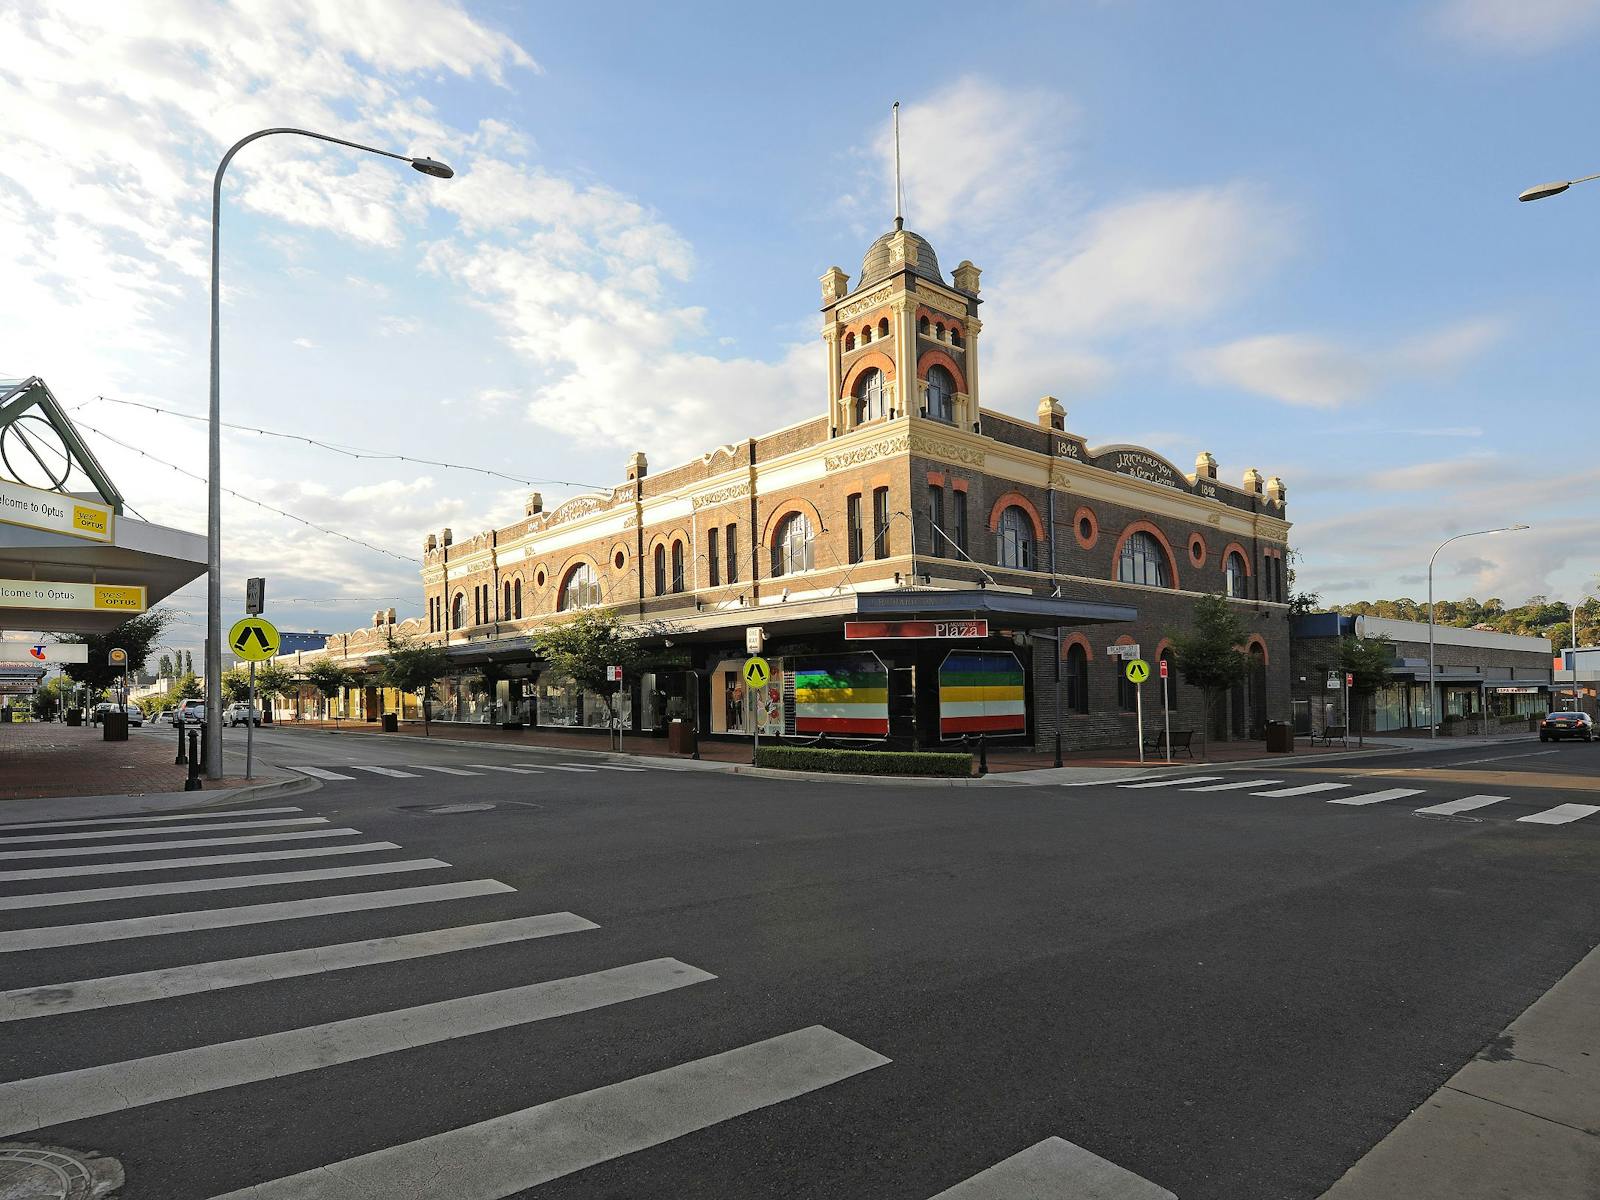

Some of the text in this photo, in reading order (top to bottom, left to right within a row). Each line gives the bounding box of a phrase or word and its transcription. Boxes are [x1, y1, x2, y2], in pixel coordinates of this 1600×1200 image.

[1057, 441, 1078, 457] 1842
[1201, 484, 1216, 497] 1842
[30, 502, 39, 513] to
[41, 503, 64, 518] Optus
[81, 519, 104, 530] OPTUS
[35, 589, 44, 598] to
[47, 589, 75, 601] Optus
[934, 622, 979, 638] Plaza
